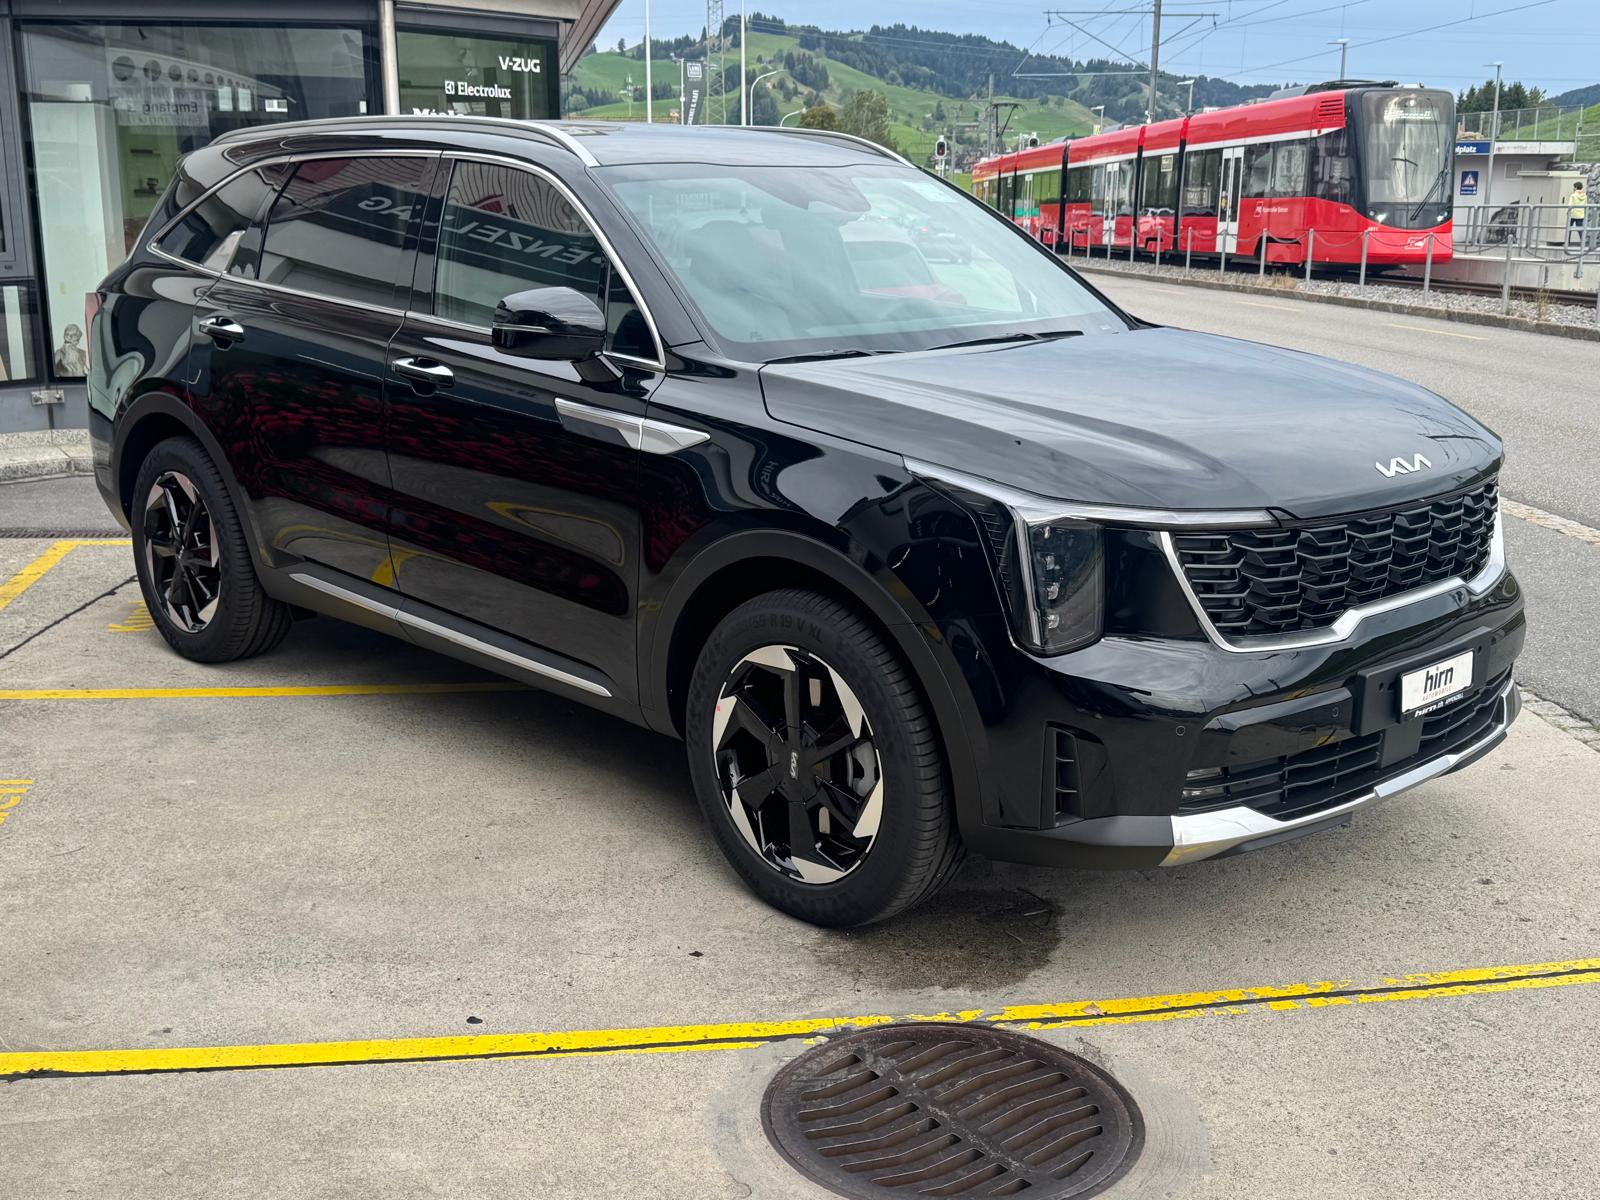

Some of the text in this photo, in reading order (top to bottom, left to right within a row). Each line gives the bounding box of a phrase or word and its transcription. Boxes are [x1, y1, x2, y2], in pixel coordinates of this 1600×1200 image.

[498, 56, 540, 73] V-ZUG
[457, 81, 511, 99] Electrolux
[412, 107, 465, 117] Mil
[1423, 666, 1454, 694] hirn
